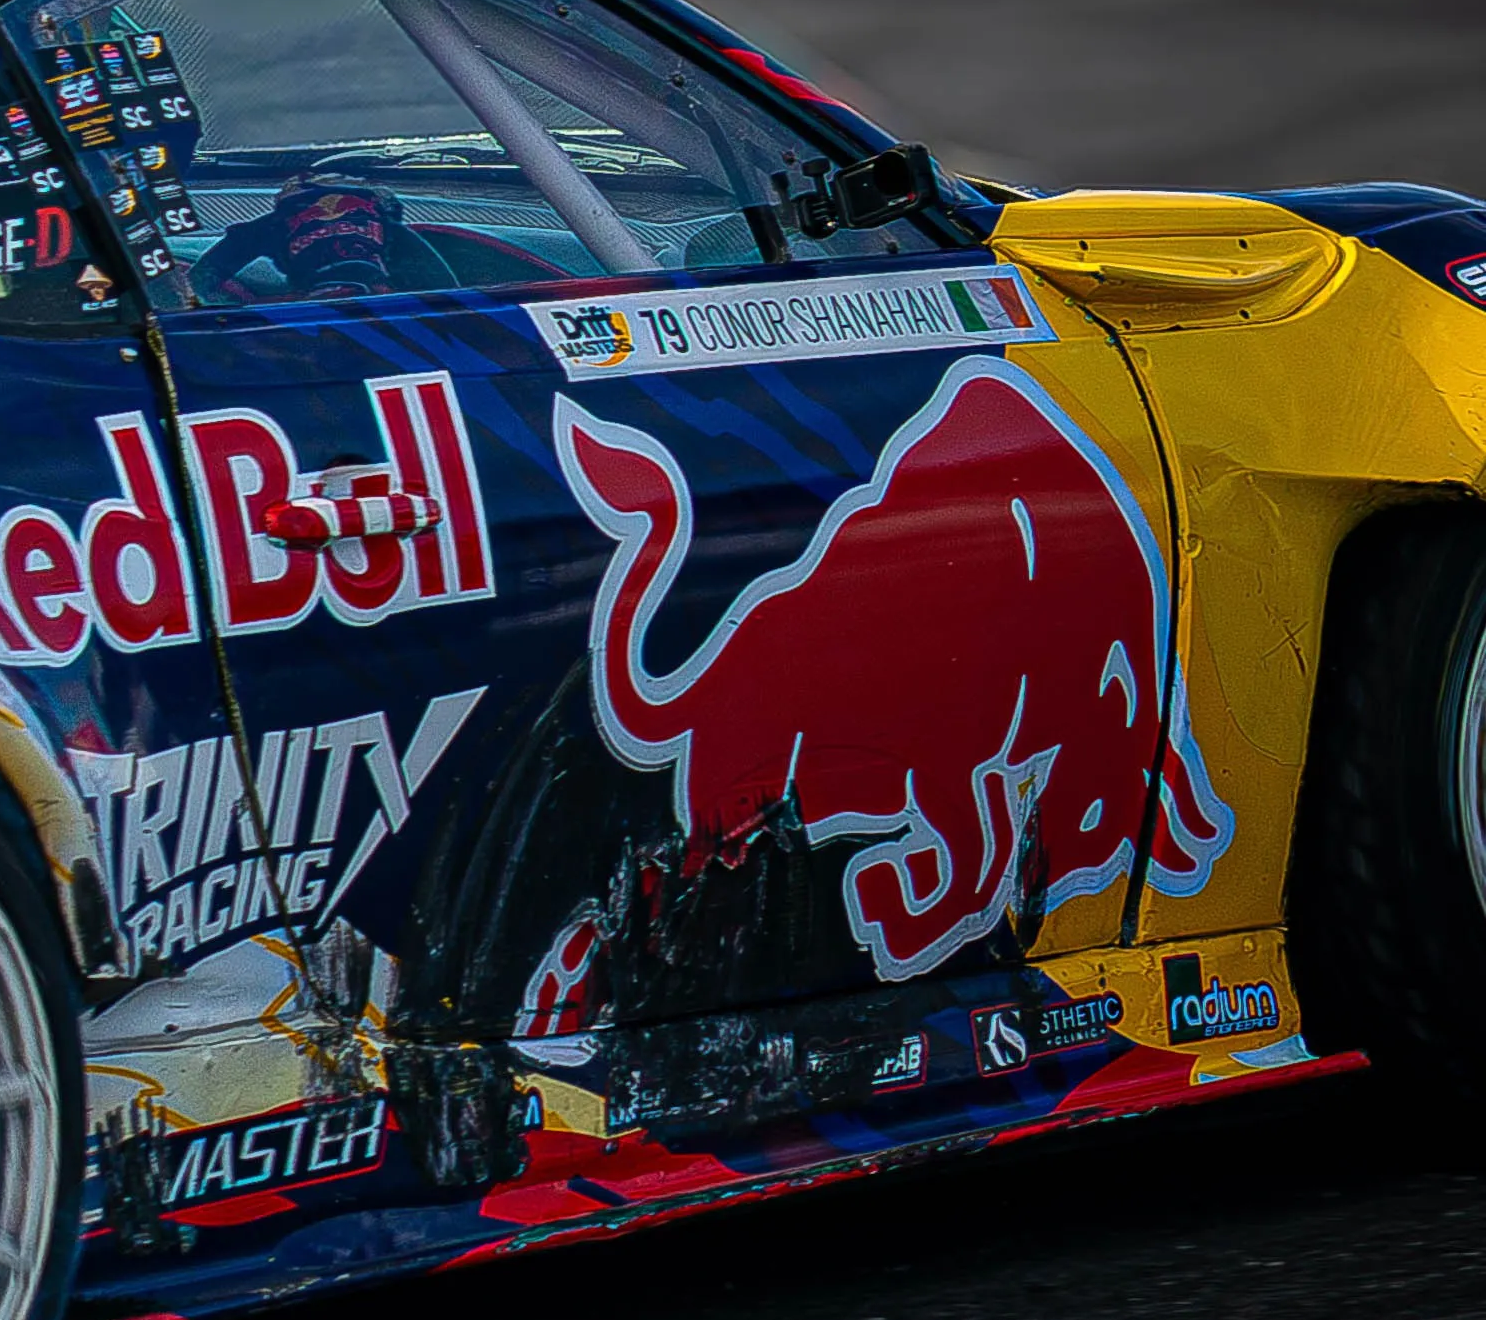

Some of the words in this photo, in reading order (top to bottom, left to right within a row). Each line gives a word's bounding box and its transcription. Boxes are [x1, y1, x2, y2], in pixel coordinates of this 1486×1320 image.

[637, 308, 691, 355] 79
[687, 300, 795, 352] CONOR
[787, 287, 953, 346] SHANAHAN
[175, 370, 497, 637] Bull
[65, 685, 489, 941] TRINITY
[125, 847, 332, 977] RACING
[1171, 980, 1276, 1031] radium
